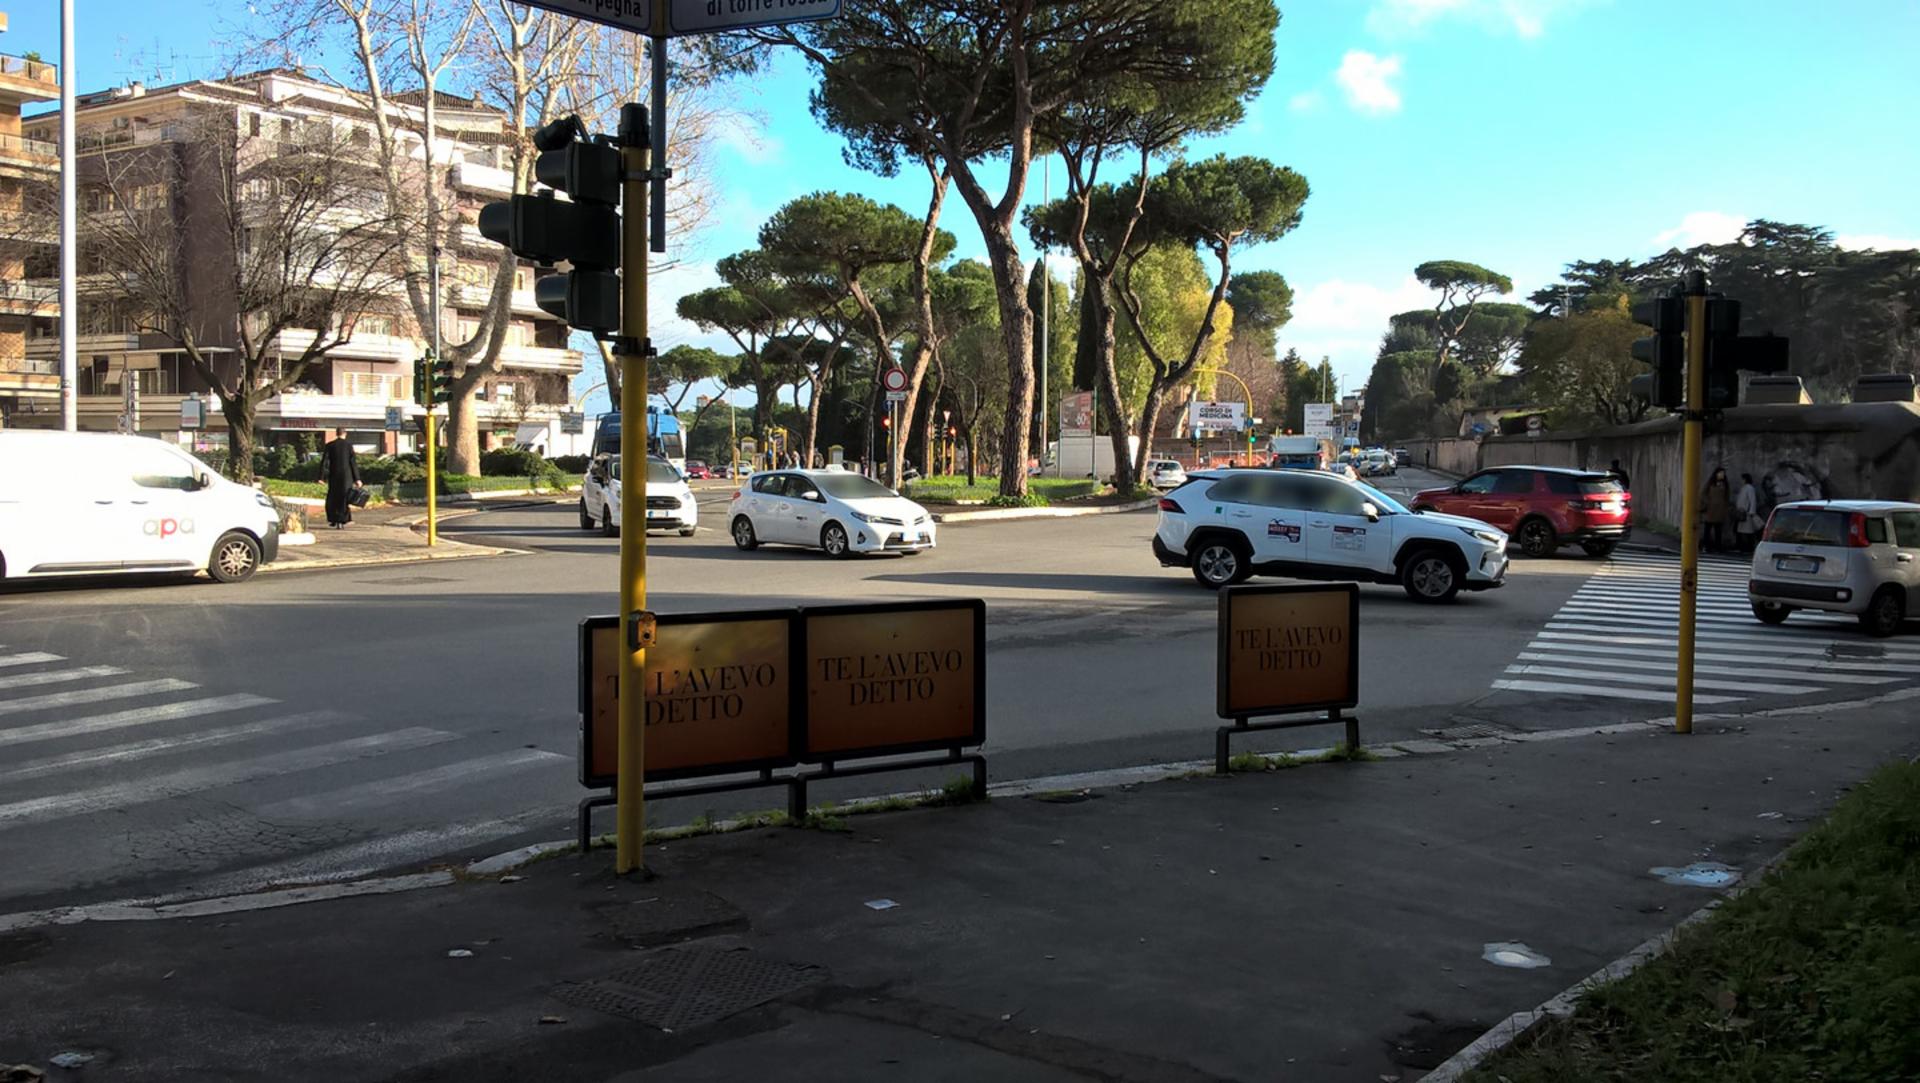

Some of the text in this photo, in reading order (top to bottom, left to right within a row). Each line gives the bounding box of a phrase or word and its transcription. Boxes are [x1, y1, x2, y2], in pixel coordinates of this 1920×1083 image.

[579, 0, 642, 17] pegna
[143, 518, 195, 539] apa
[1235, 625, 1343, 650] TE L'AVEVO
[817, 649, 963, 681] TE L'AVEVO
[1259, 648, 1322, 671] DETTO
[655, 662, 777, 697] L'AVEVO
[849, 676, 935, 706] DETTO
[645, 693, 744, 727] DETTO
